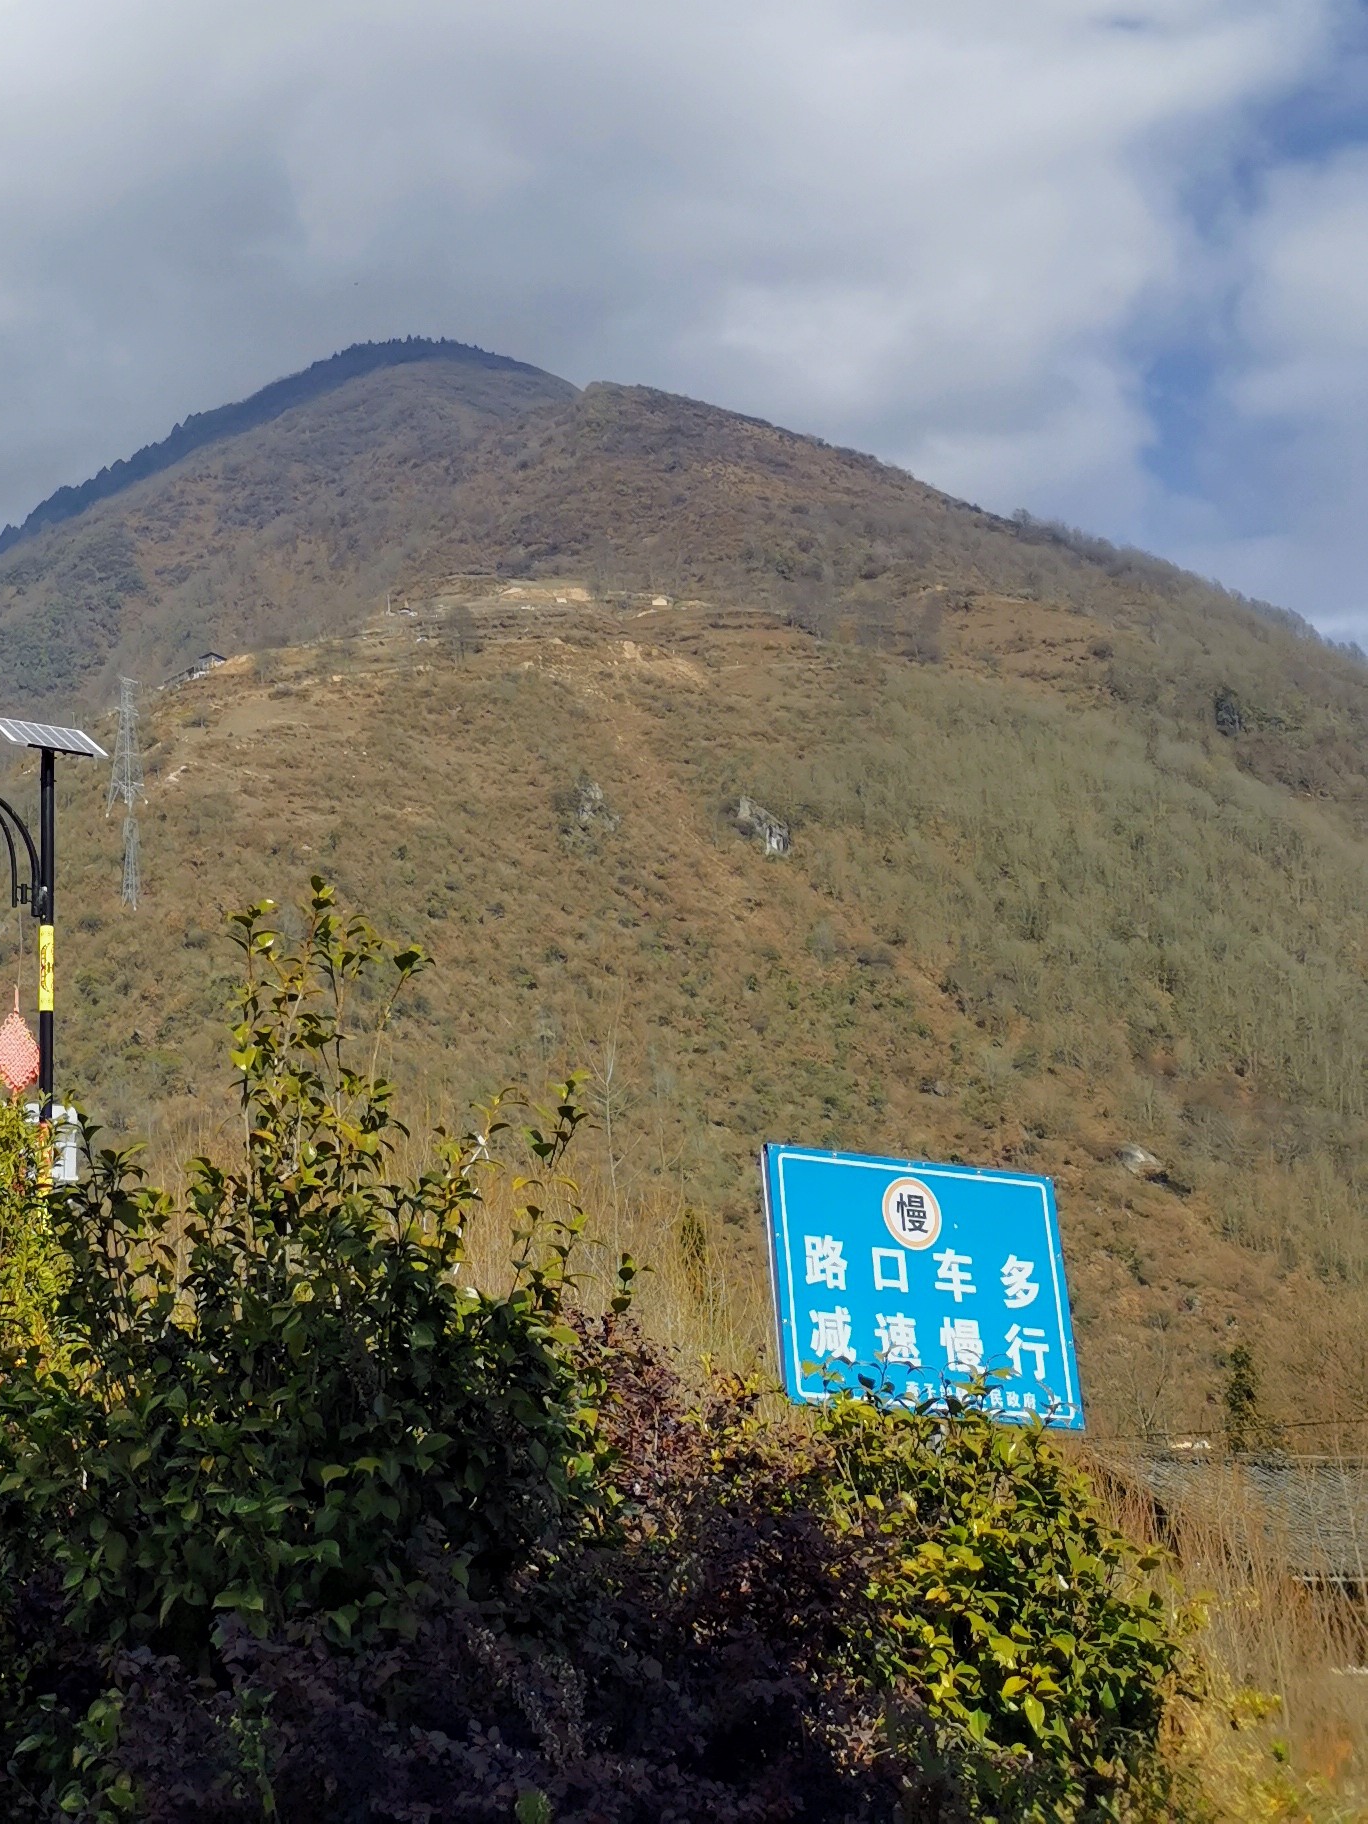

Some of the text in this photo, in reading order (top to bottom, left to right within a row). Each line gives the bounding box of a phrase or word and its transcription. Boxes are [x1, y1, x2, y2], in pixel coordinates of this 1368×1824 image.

[896, 1192, 929, 1233] 慢
[803, 1234, 1040, 1309] 路口车多
[809, 1306, 1050, 1380] 减速慢行
